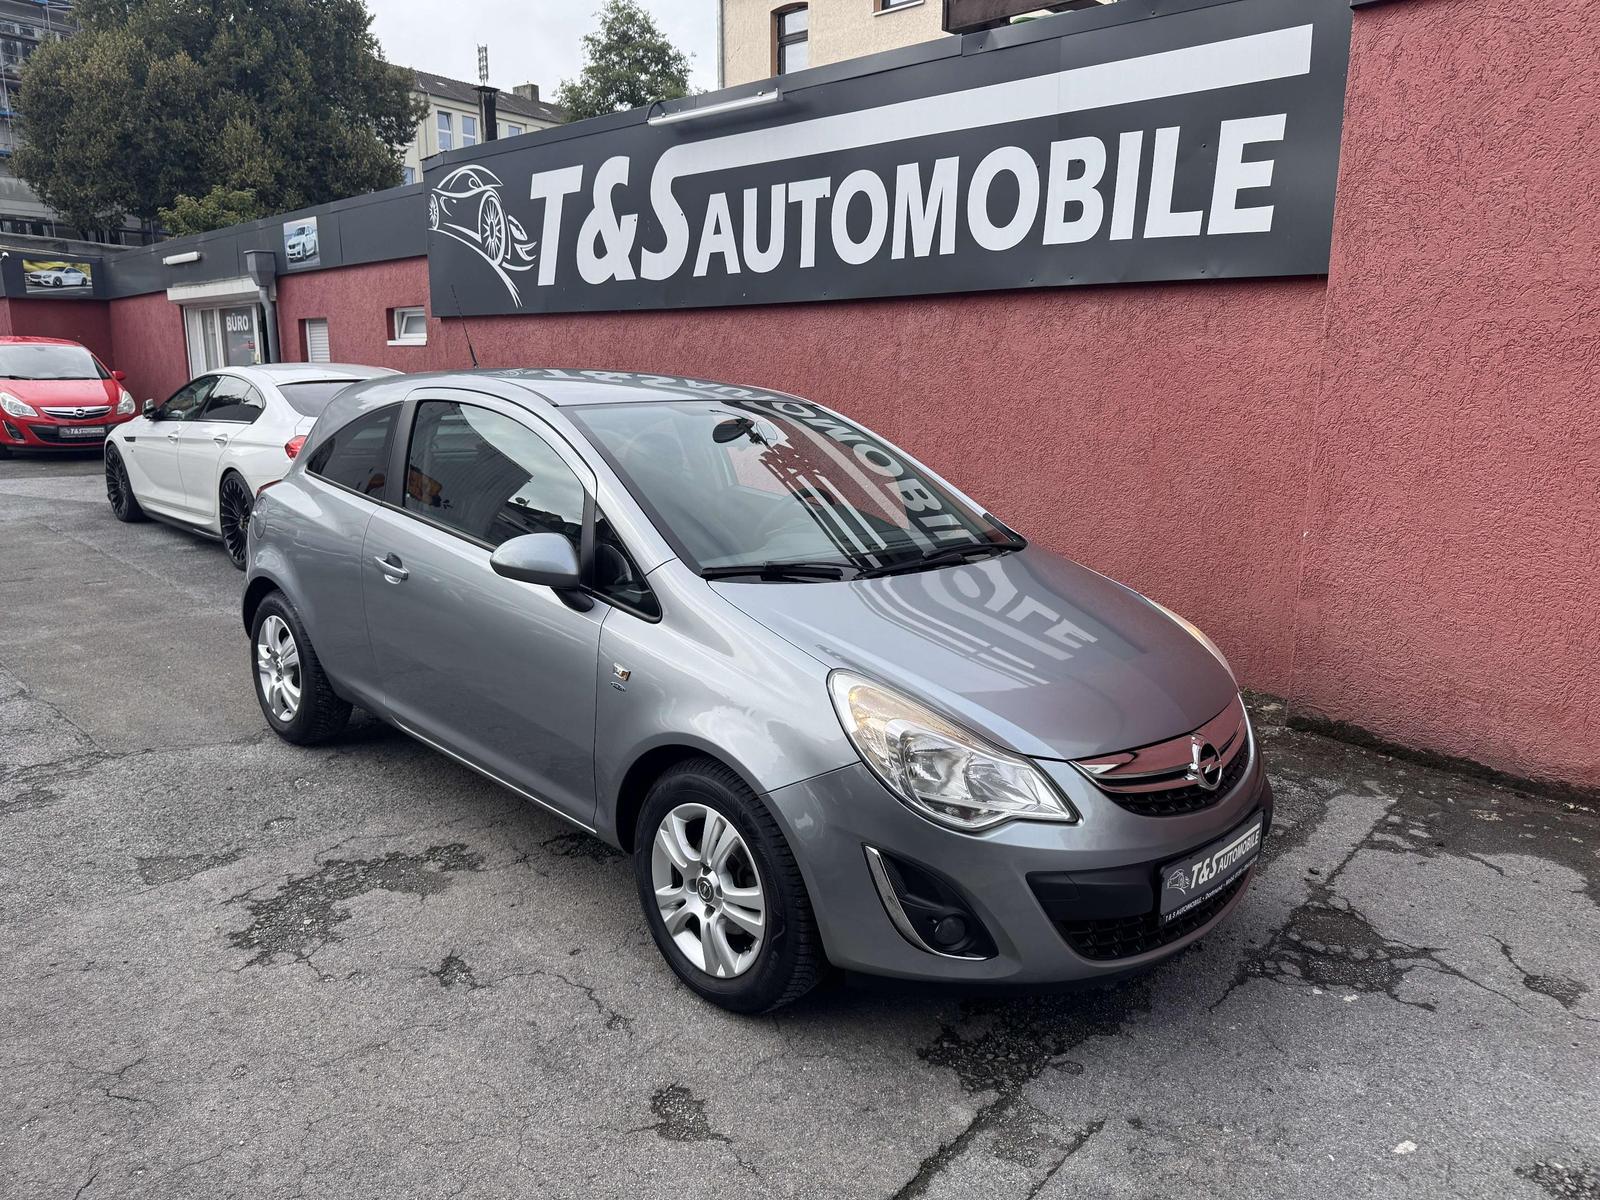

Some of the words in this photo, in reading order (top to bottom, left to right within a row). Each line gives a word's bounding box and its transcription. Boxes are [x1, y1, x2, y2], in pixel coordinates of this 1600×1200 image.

[530, 145, 693, 286] T&S
[693, 113, 1288, 277] AUTOMOBILE
[226, 313, 249, 332] BÜRO
[1191, 854, 1218, 889] T&S
[1217, 830, 1260, 874] AUTOMOBILE
